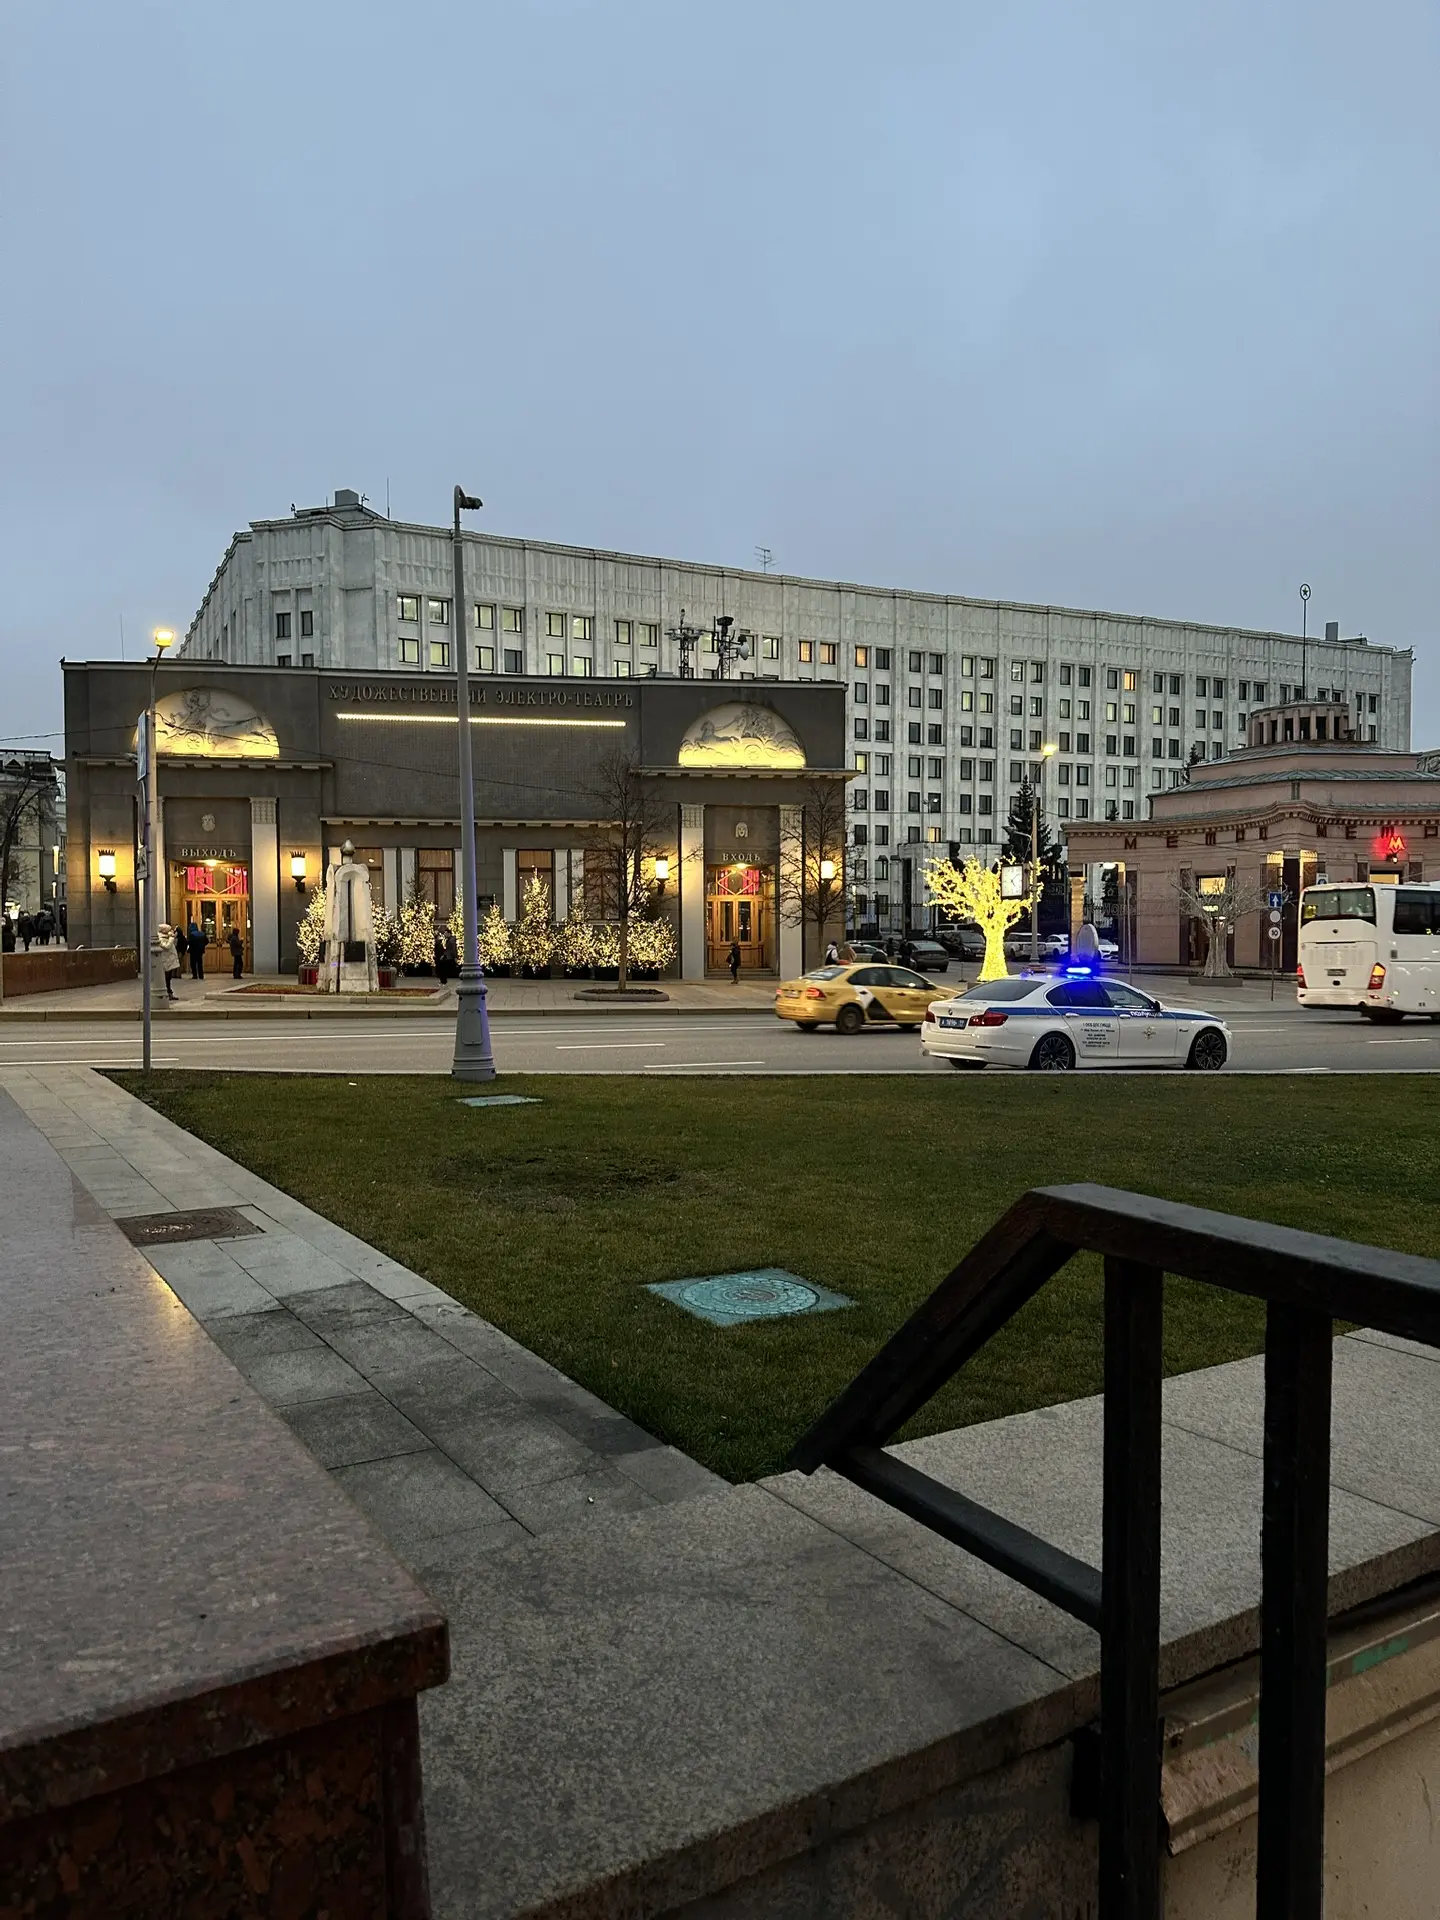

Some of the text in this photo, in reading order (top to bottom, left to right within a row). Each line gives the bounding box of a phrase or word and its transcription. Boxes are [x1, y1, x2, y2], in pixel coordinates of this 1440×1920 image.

[495, 689, 633, 708] ЭЛЕКТРО-ТЕАТРЪ
[181, 848, 236, 858] ВЫХОДЪ
[722, 853, 760, 862] ВХОДЪ
